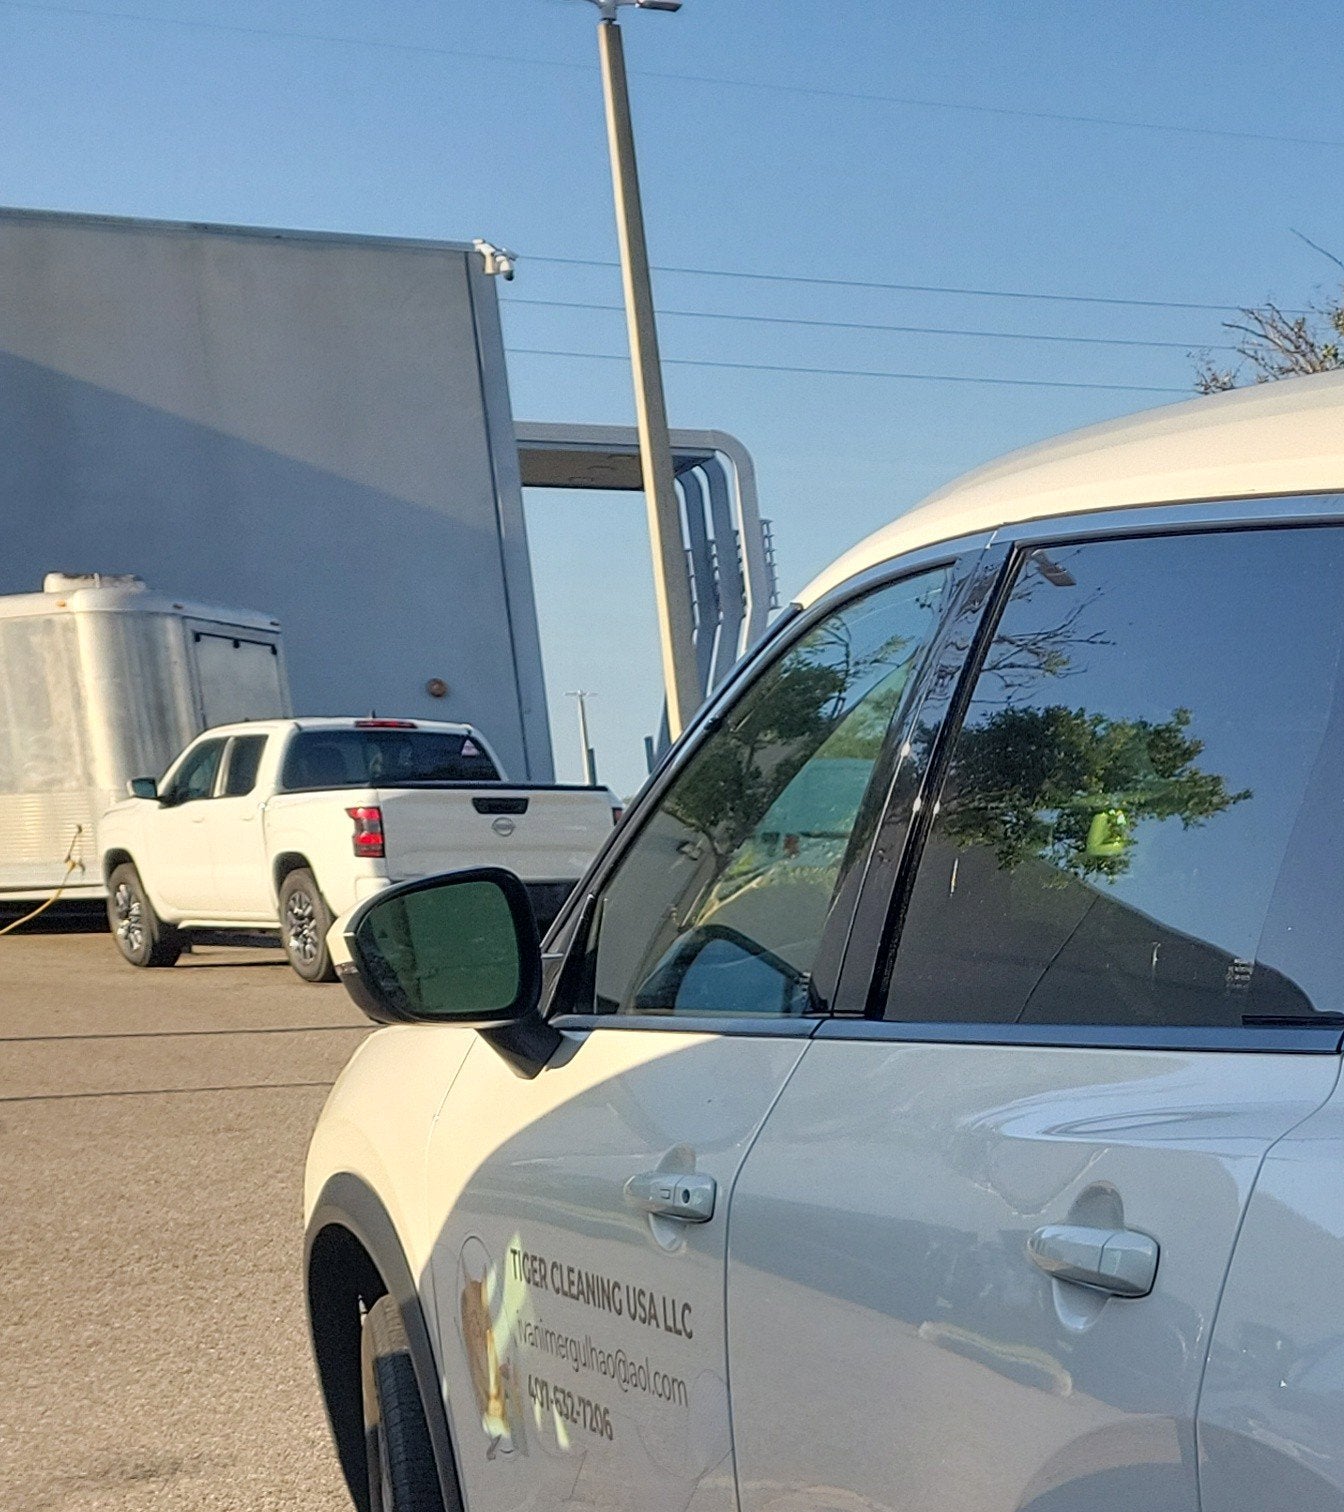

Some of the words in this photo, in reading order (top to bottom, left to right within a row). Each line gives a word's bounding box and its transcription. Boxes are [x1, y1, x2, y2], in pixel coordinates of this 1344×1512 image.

[510, 1247, 549, 1291] TIGER
[550, 1260, 622, 1316] CLEANING
[625, 1284, 660, 1329] USA
[662, 1295, 693, 1340] LLC
[528, 1373, 614, 1441] 407-632-7206
